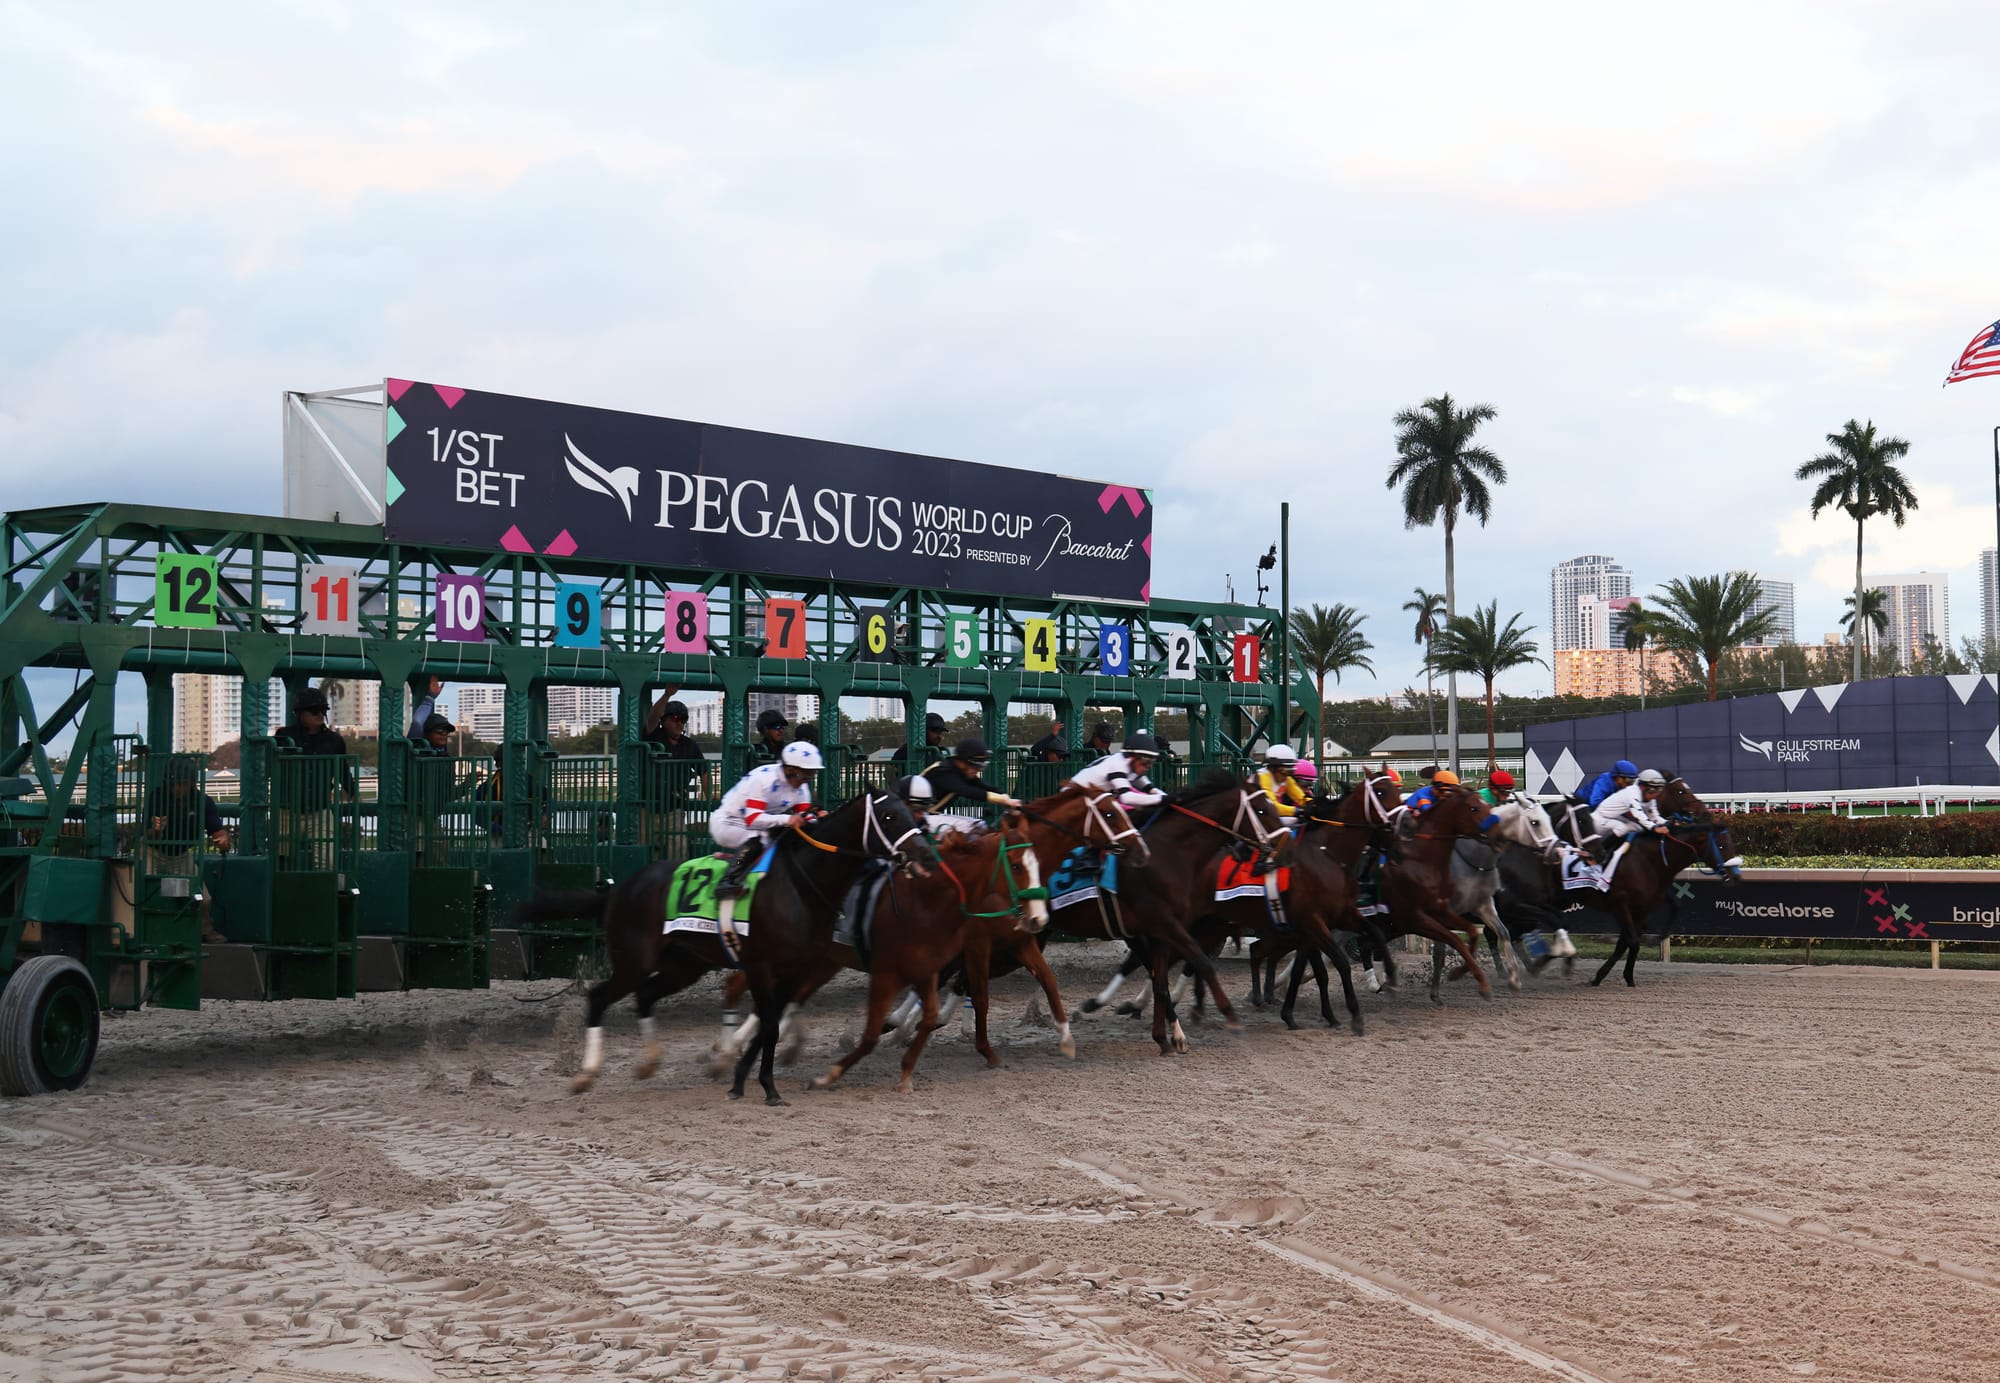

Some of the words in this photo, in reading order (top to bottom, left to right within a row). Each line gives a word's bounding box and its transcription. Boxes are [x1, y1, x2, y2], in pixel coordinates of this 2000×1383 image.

[427, 427, 503, 468] 1/ST
[456, 468, 525, 507] BET
[654, 469, 902, 551] PEGASUS
[912, 501, 987, 534] WORLD
[992, 512, 1032, 539] CUP
[912, 529, 961, 558] 2023
[966, 548, 1018, 565] PRESENTED
[1019, 554, 1031, 566] BY
[1035, 514, 1134, 571] Baccarat
[163, 566, 212, 614] 12
[310, 576, 348, 622] 11
[440, 584, 480, 630] 10
[567, 592, 590, 636] 9
[676, 601, 697, 643] 8
[776, 608, 795, 648] 7
[867, 614, 886, 654] 6
[953, 620, 971, 659] 5
[1032, 627, 1049, 662] 4
[1107, 632, 1122, 666] 3
[1176, 637, 1190, 670] 2
[1242, 642, 1252, 677] 1
[1777, 739, 1860, 751] GULFSTREAM
[1777, 751, 1810, 762] PARK
[677, 865, 713, 912] 12
